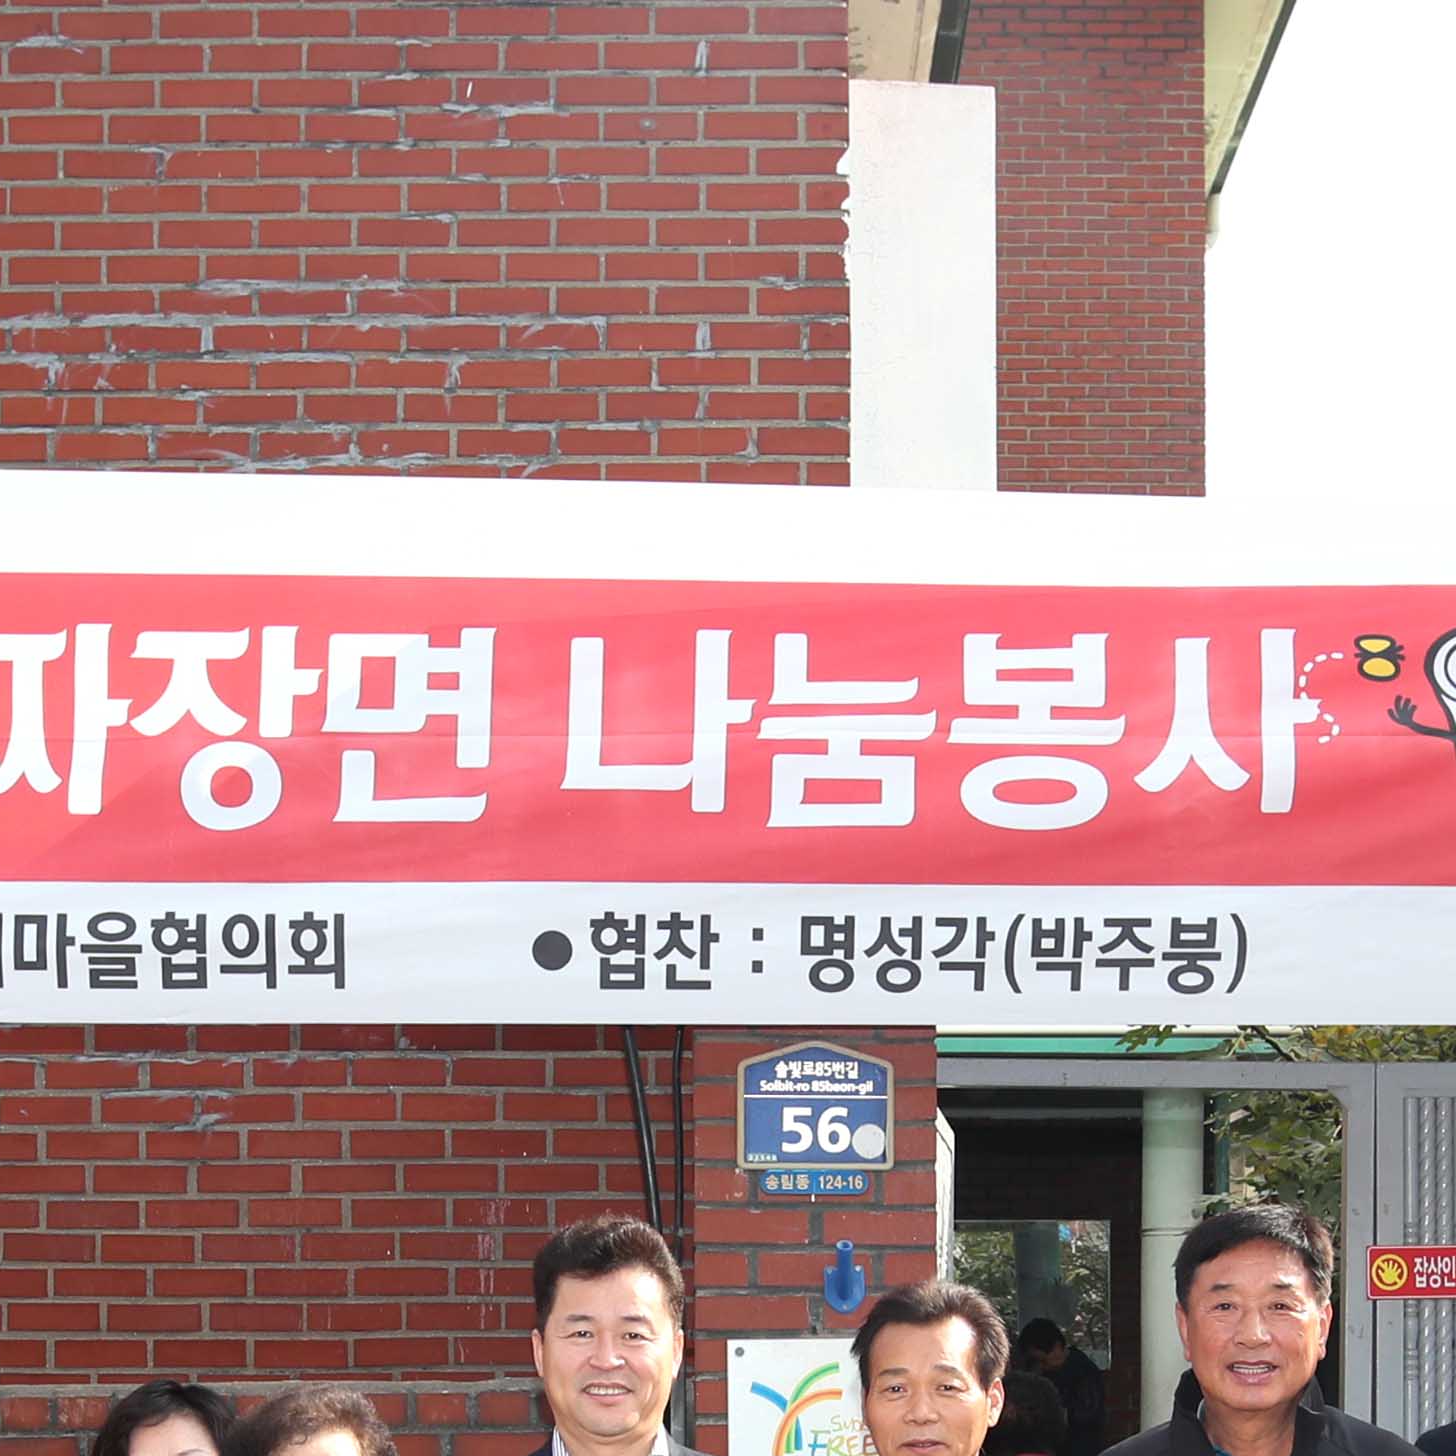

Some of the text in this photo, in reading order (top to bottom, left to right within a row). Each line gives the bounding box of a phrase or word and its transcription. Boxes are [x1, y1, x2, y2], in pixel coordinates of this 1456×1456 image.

[560, 628, 1312, 830] 나눔봉사
[589, 911, 720, 990] 협찬
[800, 913, 1247, 995] 명성각(박주붕)
[759, 1080, 874, 1095] Solbit-ro 85beon-gil
[781, 1106, 852, 1154] 56
[818, 1174, 863, 1190] 124-16
[1413, 1255, 1456, 1289] 잡상인
